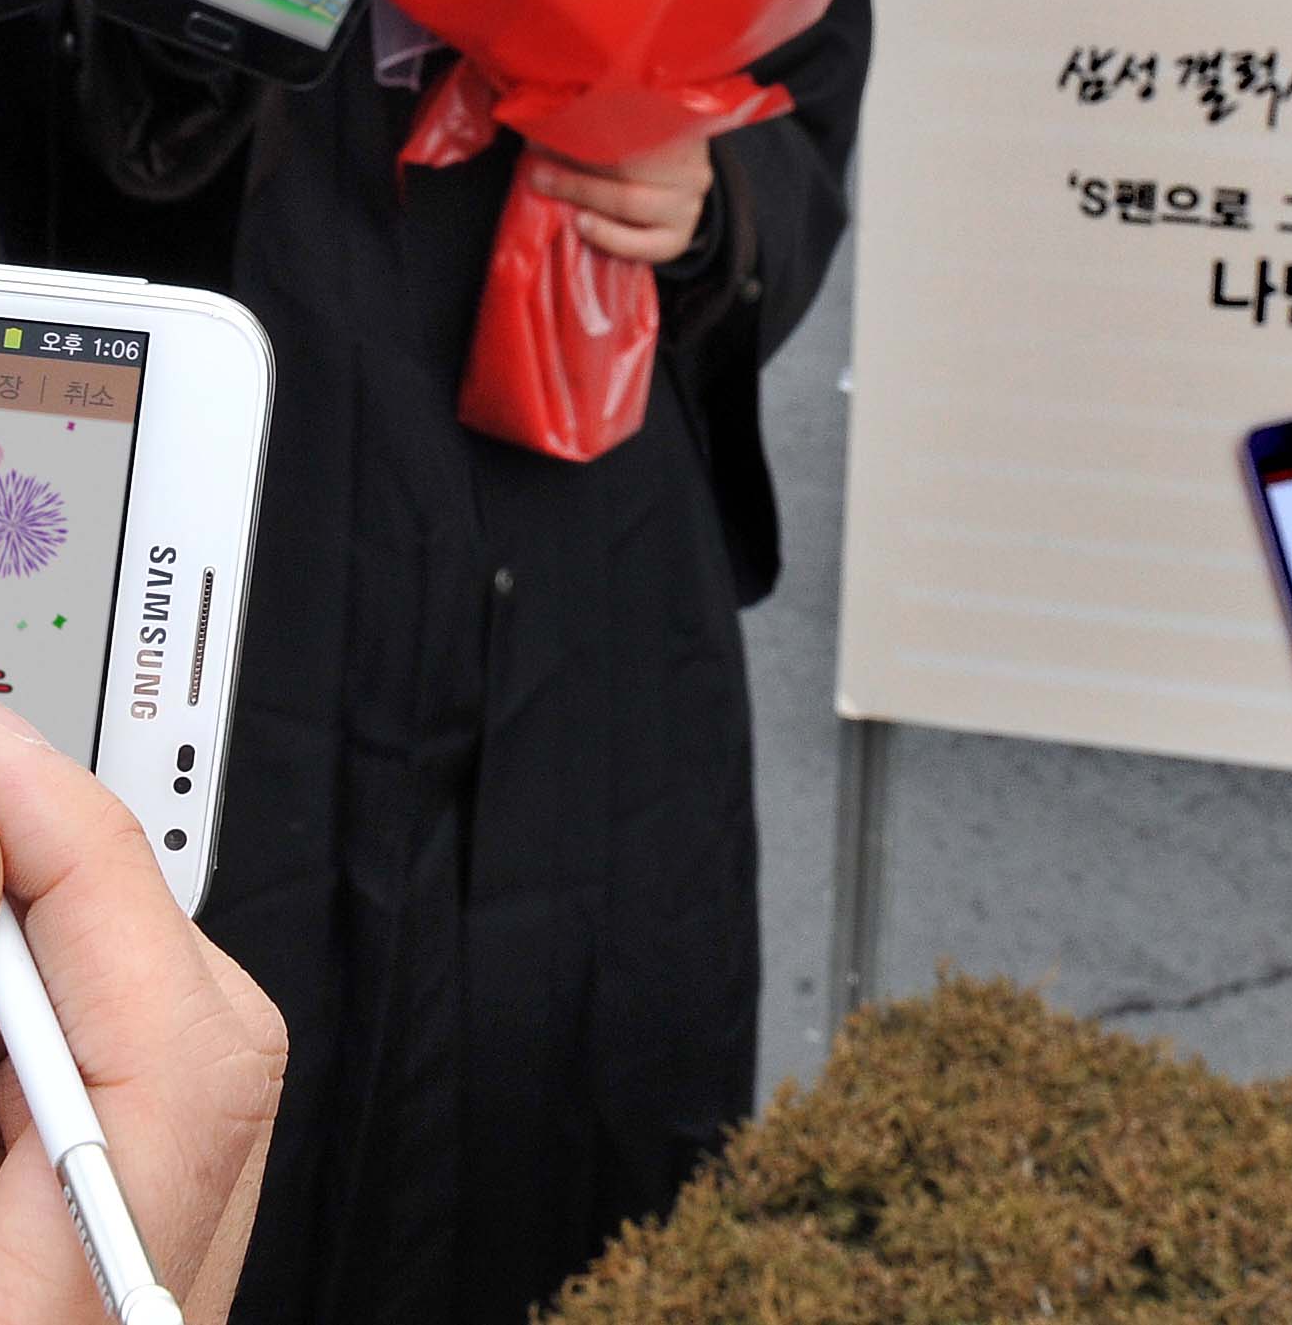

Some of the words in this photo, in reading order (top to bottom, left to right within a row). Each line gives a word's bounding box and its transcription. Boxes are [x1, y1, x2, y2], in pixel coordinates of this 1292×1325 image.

[1057, 46, 1160, 104] 삼성
[39, 331, 83, 356] 오후
[93, 338, 140, 360] 1:06
[63, 380, 114, 408] 취소
[130, 545, 177, 720] SAMSUNG
